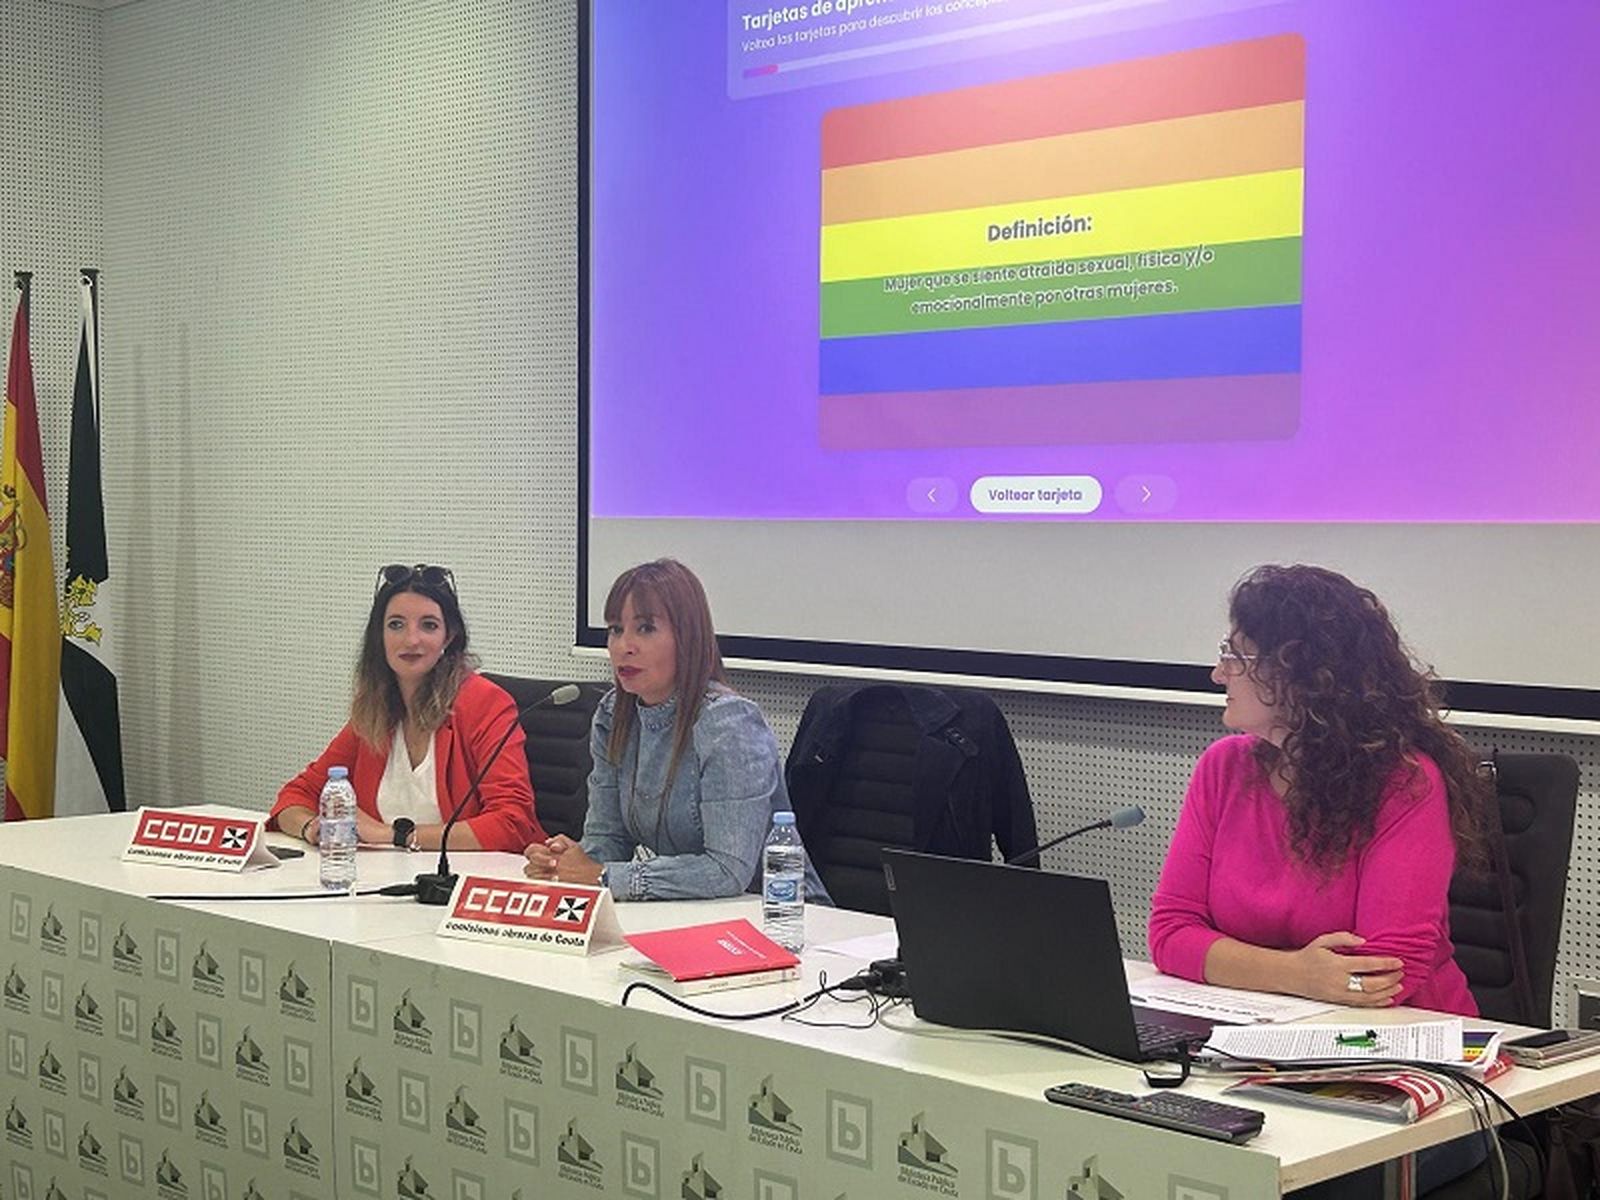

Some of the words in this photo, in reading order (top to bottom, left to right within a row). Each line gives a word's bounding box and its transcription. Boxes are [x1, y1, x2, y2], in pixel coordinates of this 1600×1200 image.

[741, 37, 776, 52] Voltea
[795, 25, 837, 42] tarjetas
[839, 19, 867, 36] para
[868, 8, 923, 28] descubrir
[742, 5, 808, 31] Tarjetas
[811, 0, 832, 16] de
[987, 214, 1092, 242] Definición:
[884, 277, 924, 294] Mujer
[924, 274, 952, 291] que
[953, 271, 970, 286] se
[972, 265, 1018, 285] siente
[1184, 244, 1214, 268] y/o
[911, 291, 1033, 315] emocionalmente
[1034, 290, 1064, 308] por
[1063, 284, 1104, 301] otras
[1107, 279, 1178, 299] mujeres.
[988, 488, 1035, 501] Voltear
[1037, 488, 1083, 504] tarjeta
[142, 819, 216, 845] CCOO
[463, 886, 549, 918] CCOO
